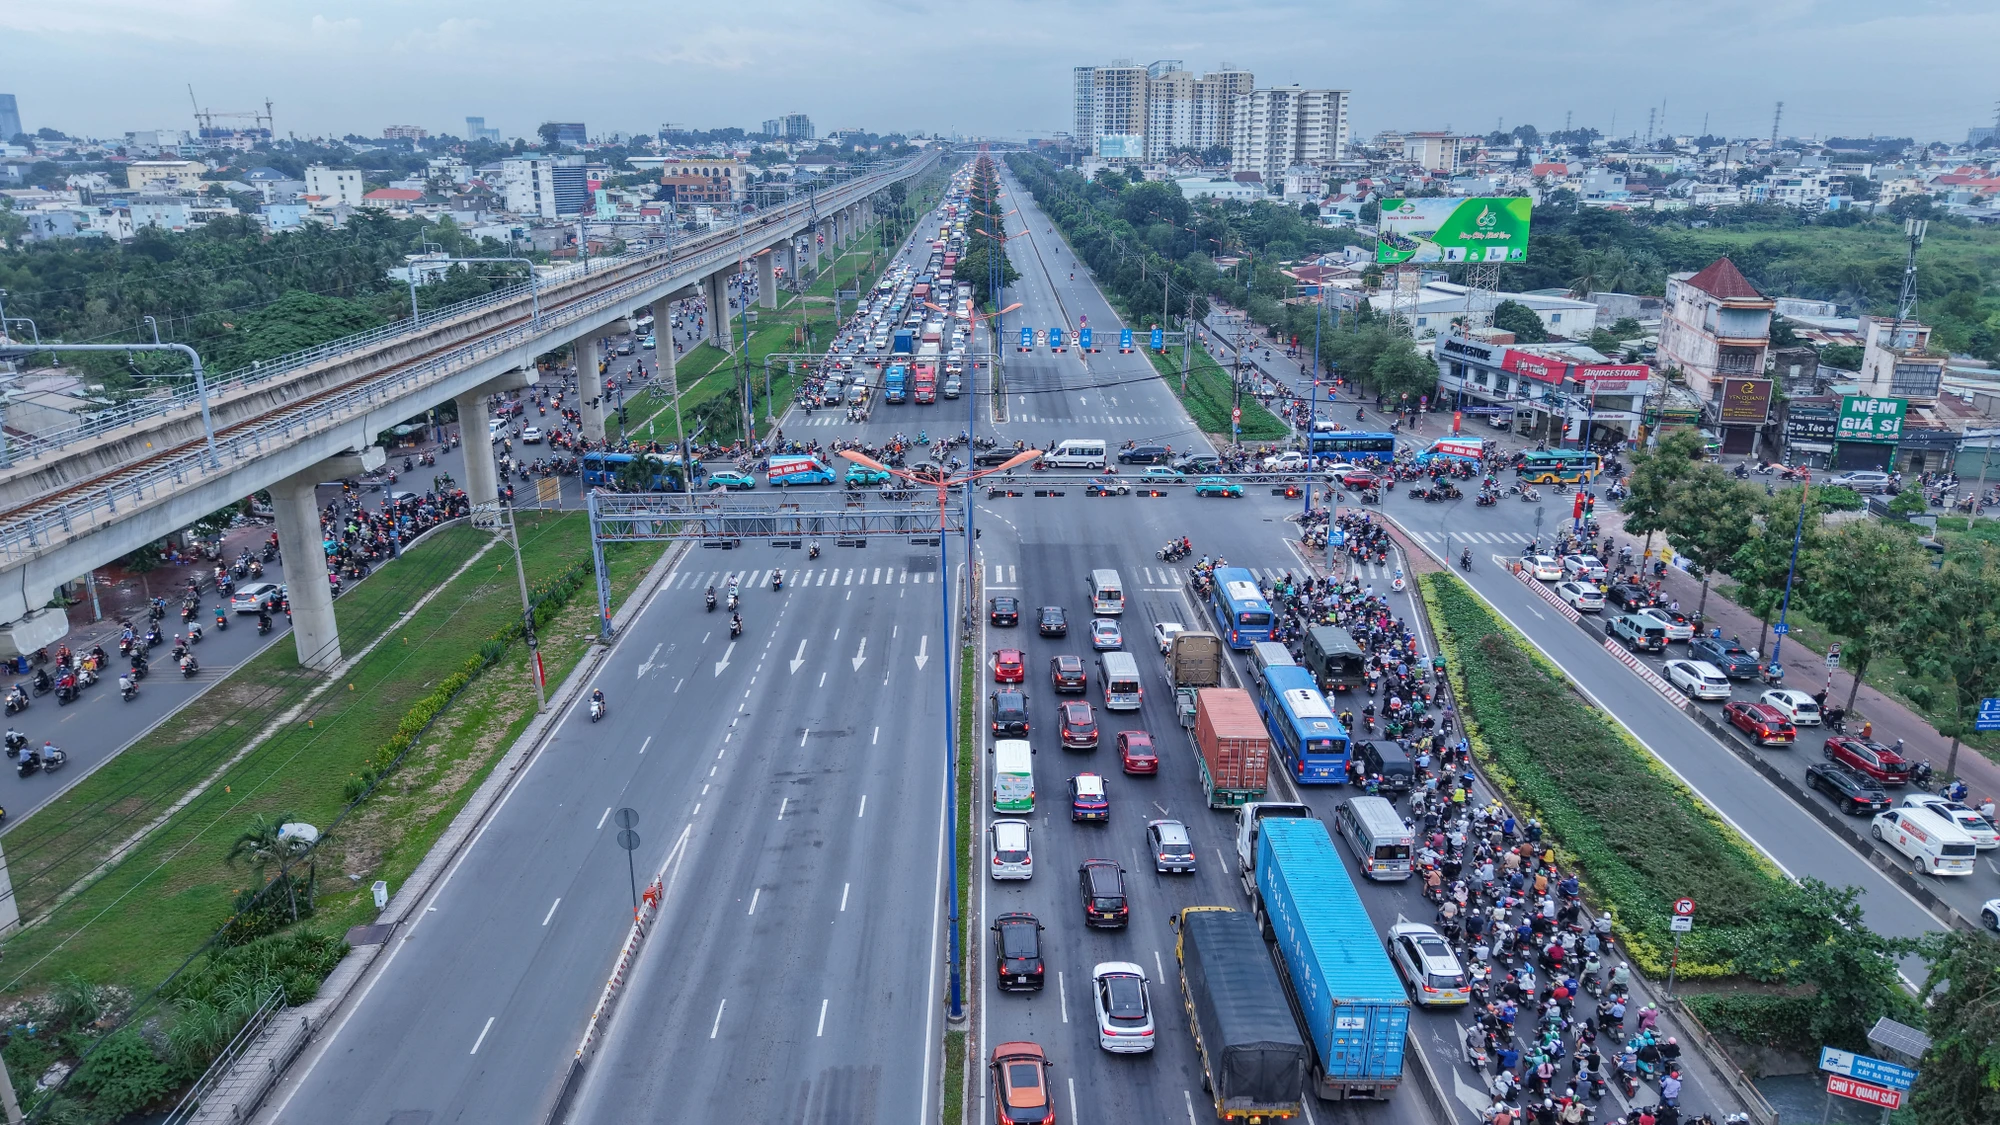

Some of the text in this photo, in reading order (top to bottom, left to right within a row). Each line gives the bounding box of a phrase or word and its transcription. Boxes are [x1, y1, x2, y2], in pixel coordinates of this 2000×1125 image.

[1583, 369, 1641, 377] BRIDGESTONE
[1851, 399, 1898, 415] NỆM
[1856, 1086, 1880, 1101] QUAN
[1880, 1090, 1898, 1106] SÁT
